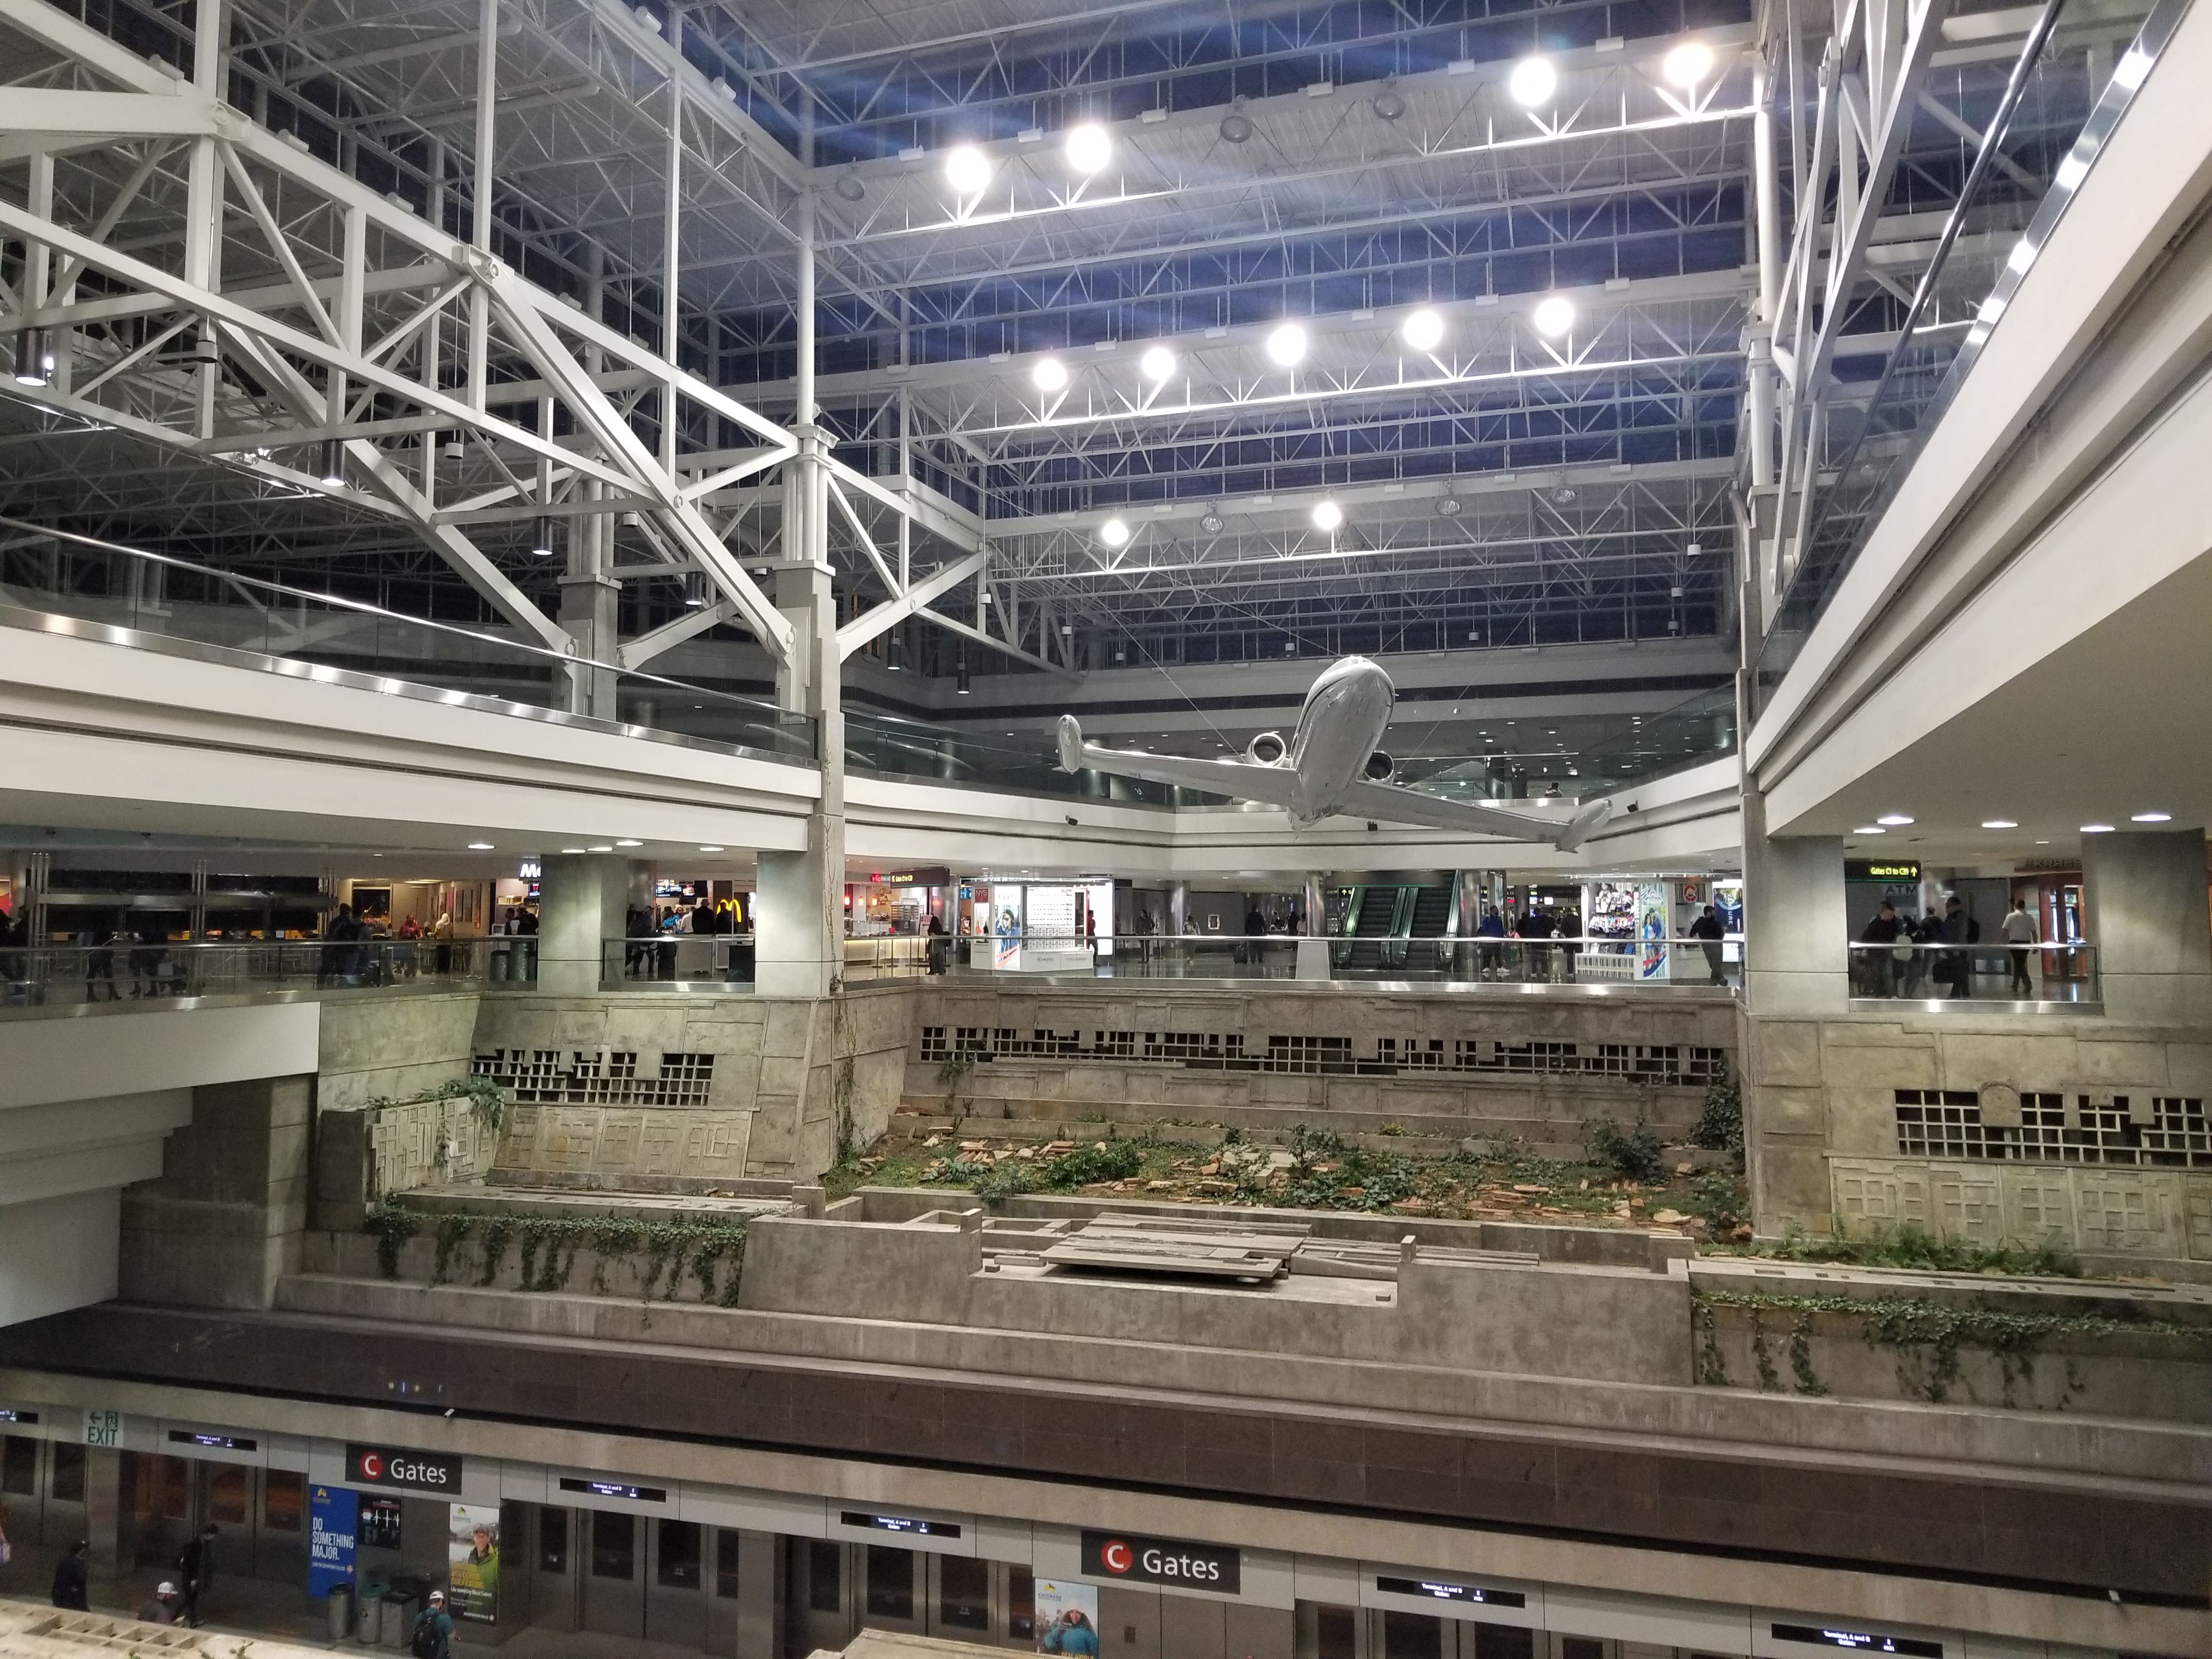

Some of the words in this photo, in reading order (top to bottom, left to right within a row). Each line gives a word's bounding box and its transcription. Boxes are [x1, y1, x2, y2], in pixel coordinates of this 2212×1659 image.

[1886, 884, 1917, 894] ATM
[88, 1426, 118, 1446] EXIT
[364, 1455, 377, 1476] C
[391, 1458, 447, 1484] Gates
[313, 1517, 323, 1530] DO
[312, 1531, 354, 1549] SOMETHING
[312, 1544, 340, 1560] MAJOR.
[1107, 1545, 1124, 1569] C
[1143, 1549, 1220, 1581] Gates
